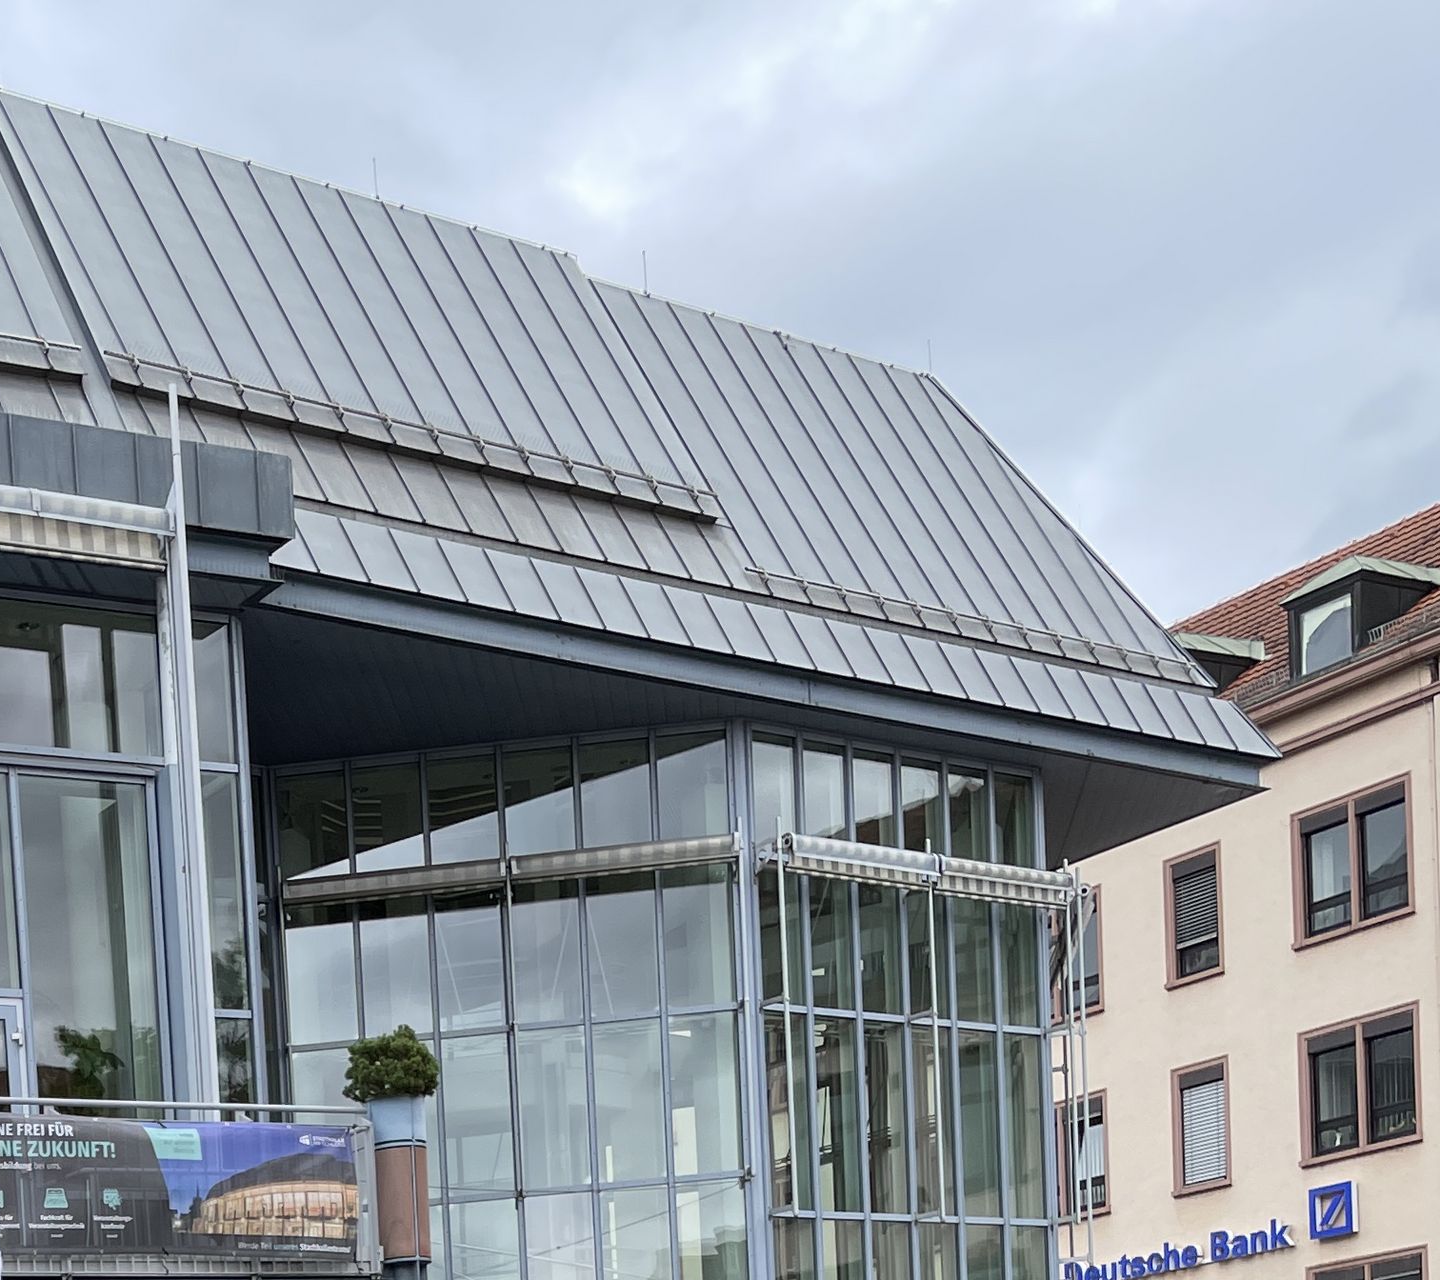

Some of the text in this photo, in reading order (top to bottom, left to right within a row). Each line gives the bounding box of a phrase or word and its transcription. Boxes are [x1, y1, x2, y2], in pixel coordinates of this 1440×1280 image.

[16, 1123, 45, 1136] FREI
[48, 1121, 74, 1137] FÜR
[27, 1140, 116, 1158] ZUKUNFT!
[1210, 1219, 1295, 1263] Bank
